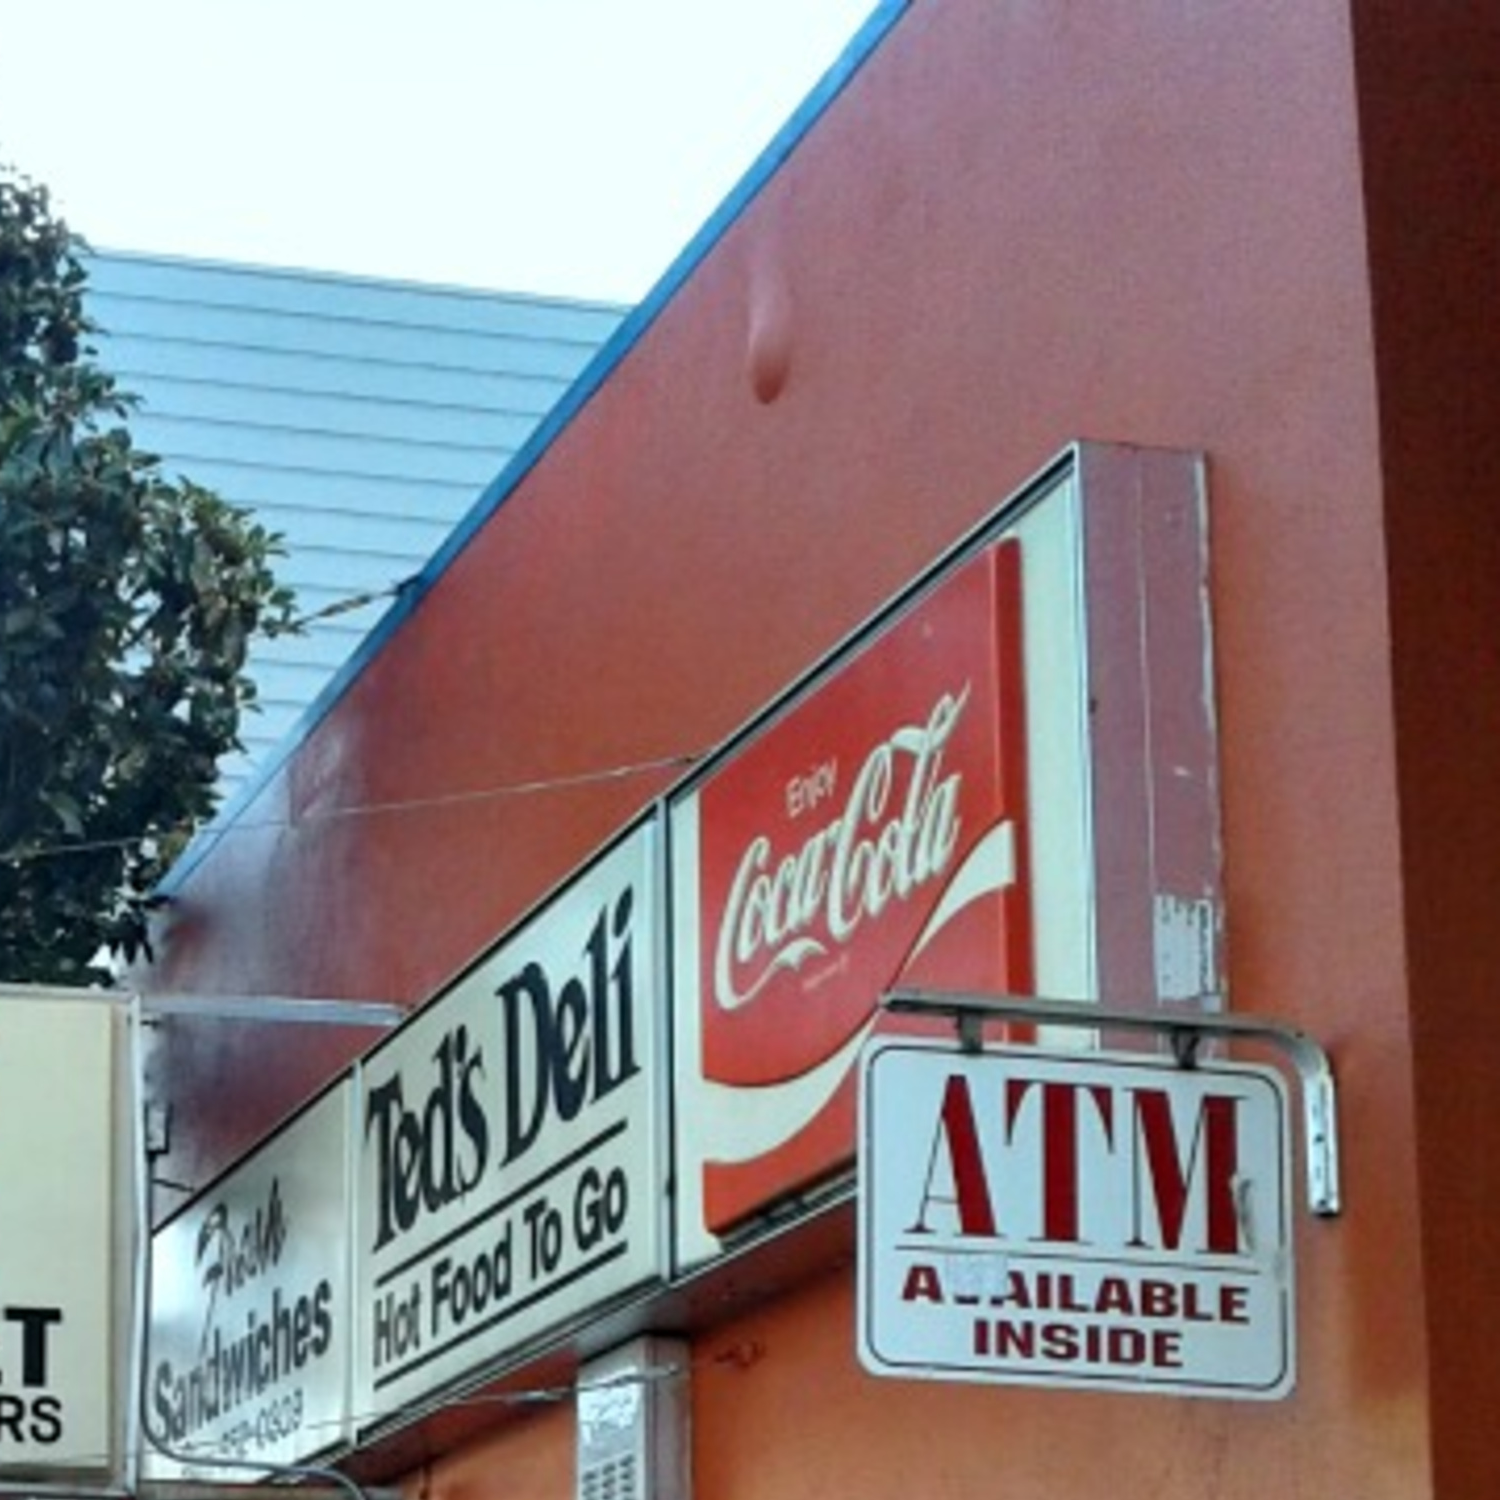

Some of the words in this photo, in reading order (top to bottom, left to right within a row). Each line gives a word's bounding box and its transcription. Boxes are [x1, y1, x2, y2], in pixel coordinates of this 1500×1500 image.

[715, 679, 972, 1011] Coca-Cola
[786, 758, 838, 819] Enjoy
[363, 1023, 490, 1255] Ted's
[495, 884, 642, 1168] Deli
[902, 1073, 1251, 1259] ATM
[373, 1280, 423, 1371] Hot
[430, 1218, 513, 1340] Food
[524, 1196, 563, 1282] To
[573, 1164, 629, 1253] Go
[901, 1264, 1251, 1325] AAILABLE
[973, 1320, 1183, 1369] INSIDE
[156, 1279, 332, 1443] Sandwiches
